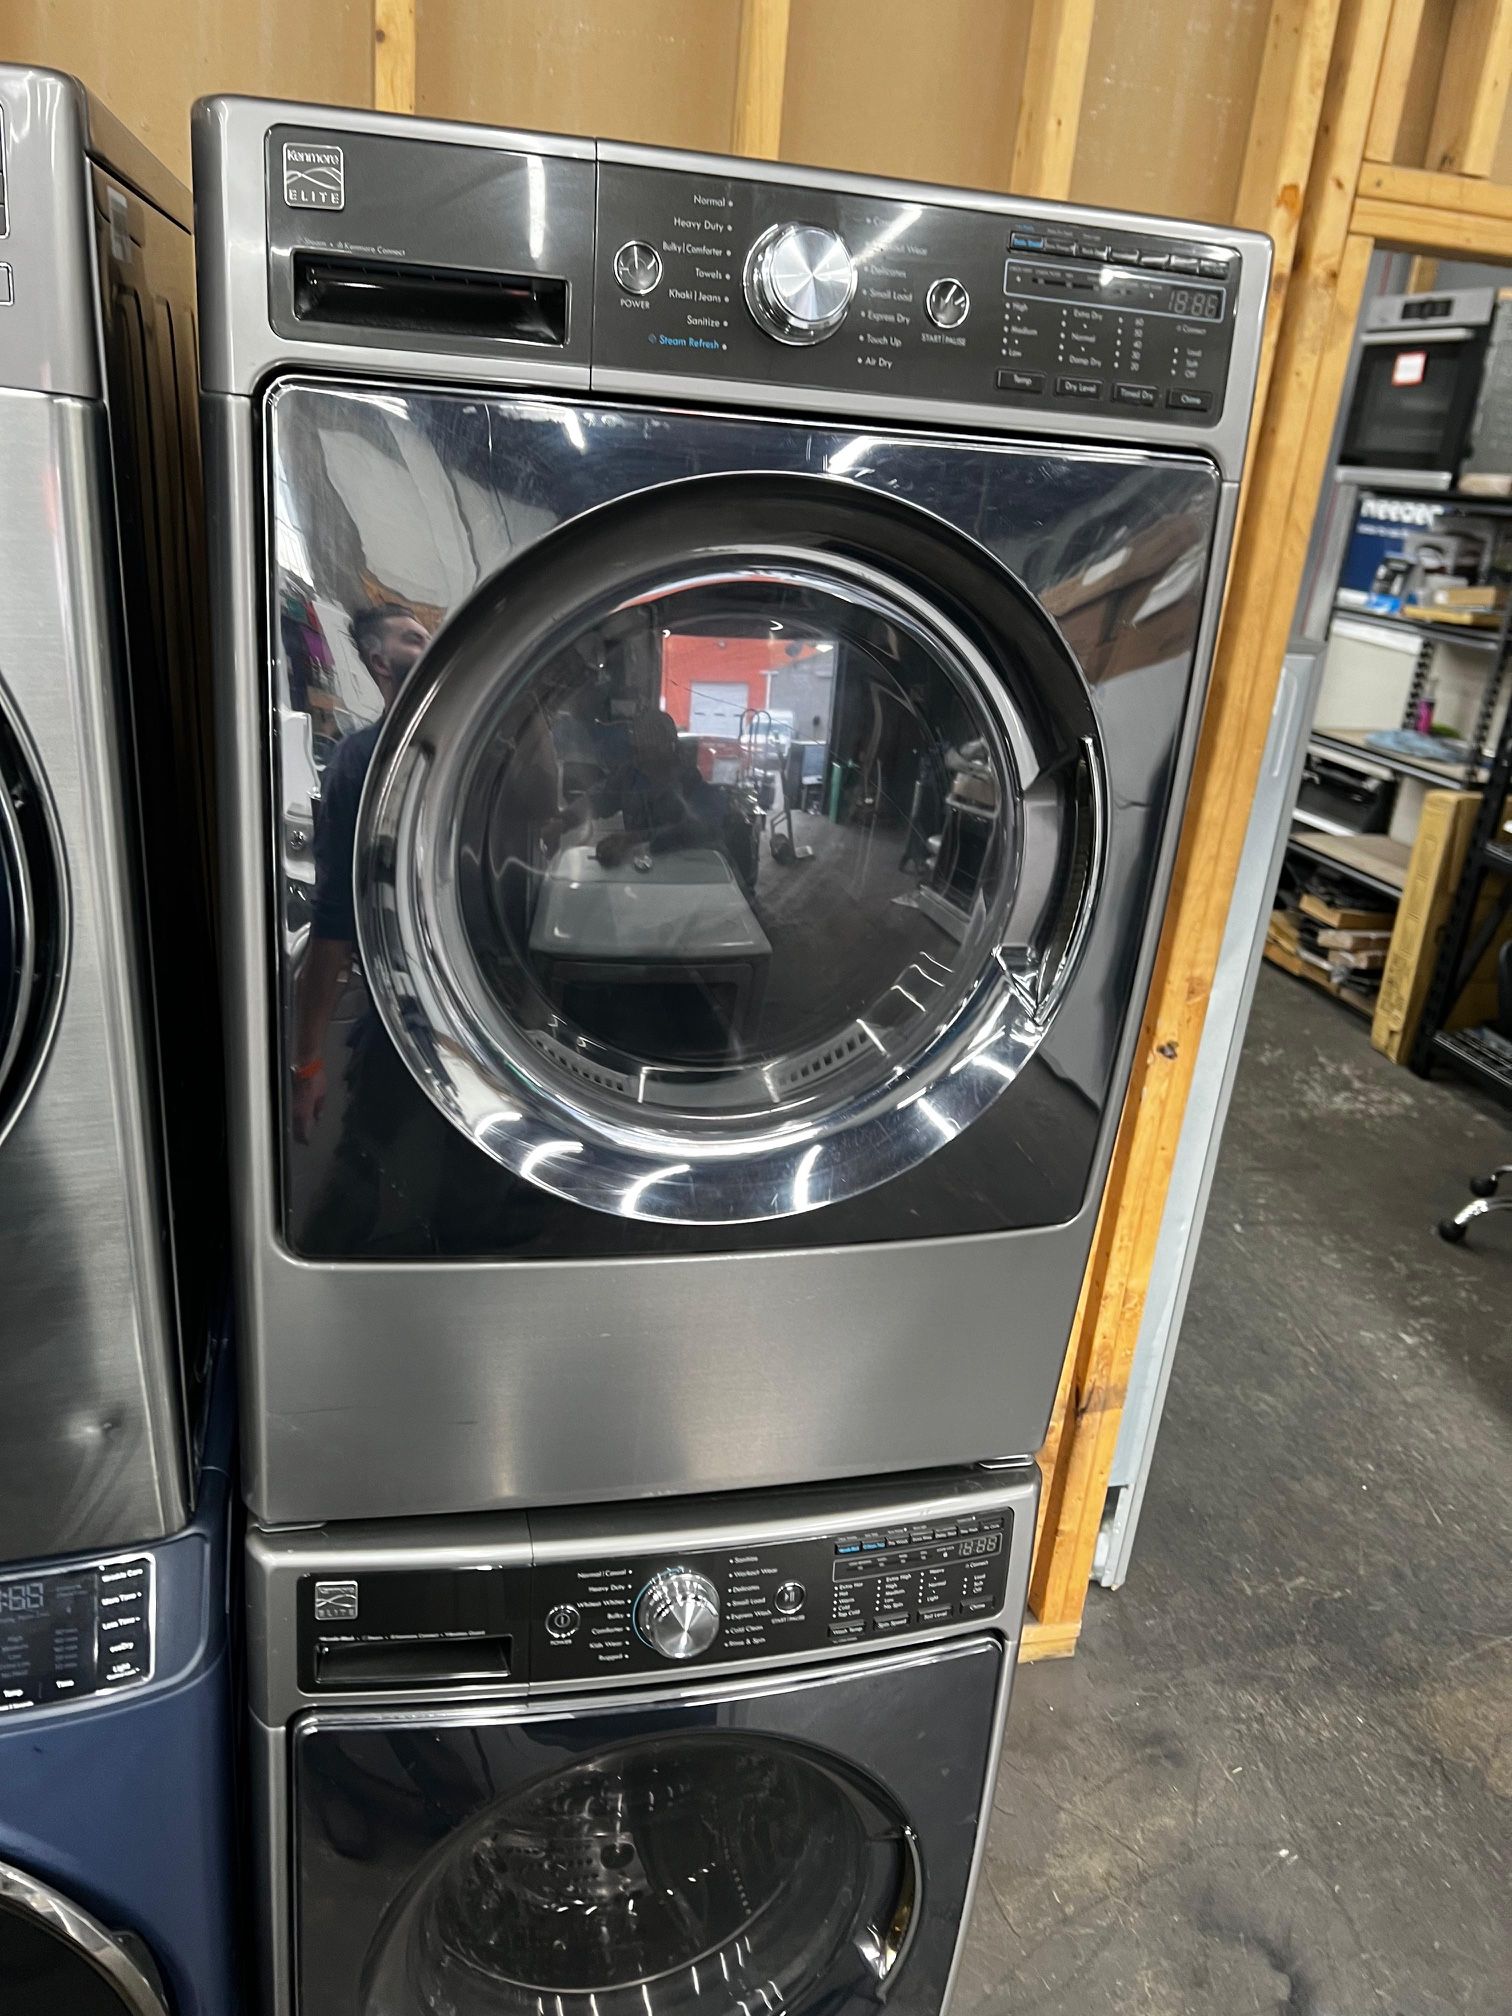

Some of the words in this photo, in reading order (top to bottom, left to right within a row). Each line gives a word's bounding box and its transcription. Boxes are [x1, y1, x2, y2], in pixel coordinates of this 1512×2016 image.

[287, 149, 340, 165] Kenmore
[288, 189, 340, 204] ELITE
[693, 194, 726, 208] Normal
[673, 216, 701, 231] Heavy
[704, 220, 724, 233] Duty
[695, 267, 723, 280] Towels
[620, 298, 650, 310] POWER
[686, 314, 721, 328] Sanitize
[867, 309, 895, 323] Express
[896, 313, 910, 326] Dry
[659, 334, 687, 347] Steam
[688, 336, 720, 350] Refresh
[866, 333, 889, 347] Touch
[890, 336, 902, 348] Up
[865, 356, 877, 367] Air
[878, 357, 893, 370] Dry
[1065, 380, 1078, 393] Dry
[1079, 383, 1097, 394] Level
